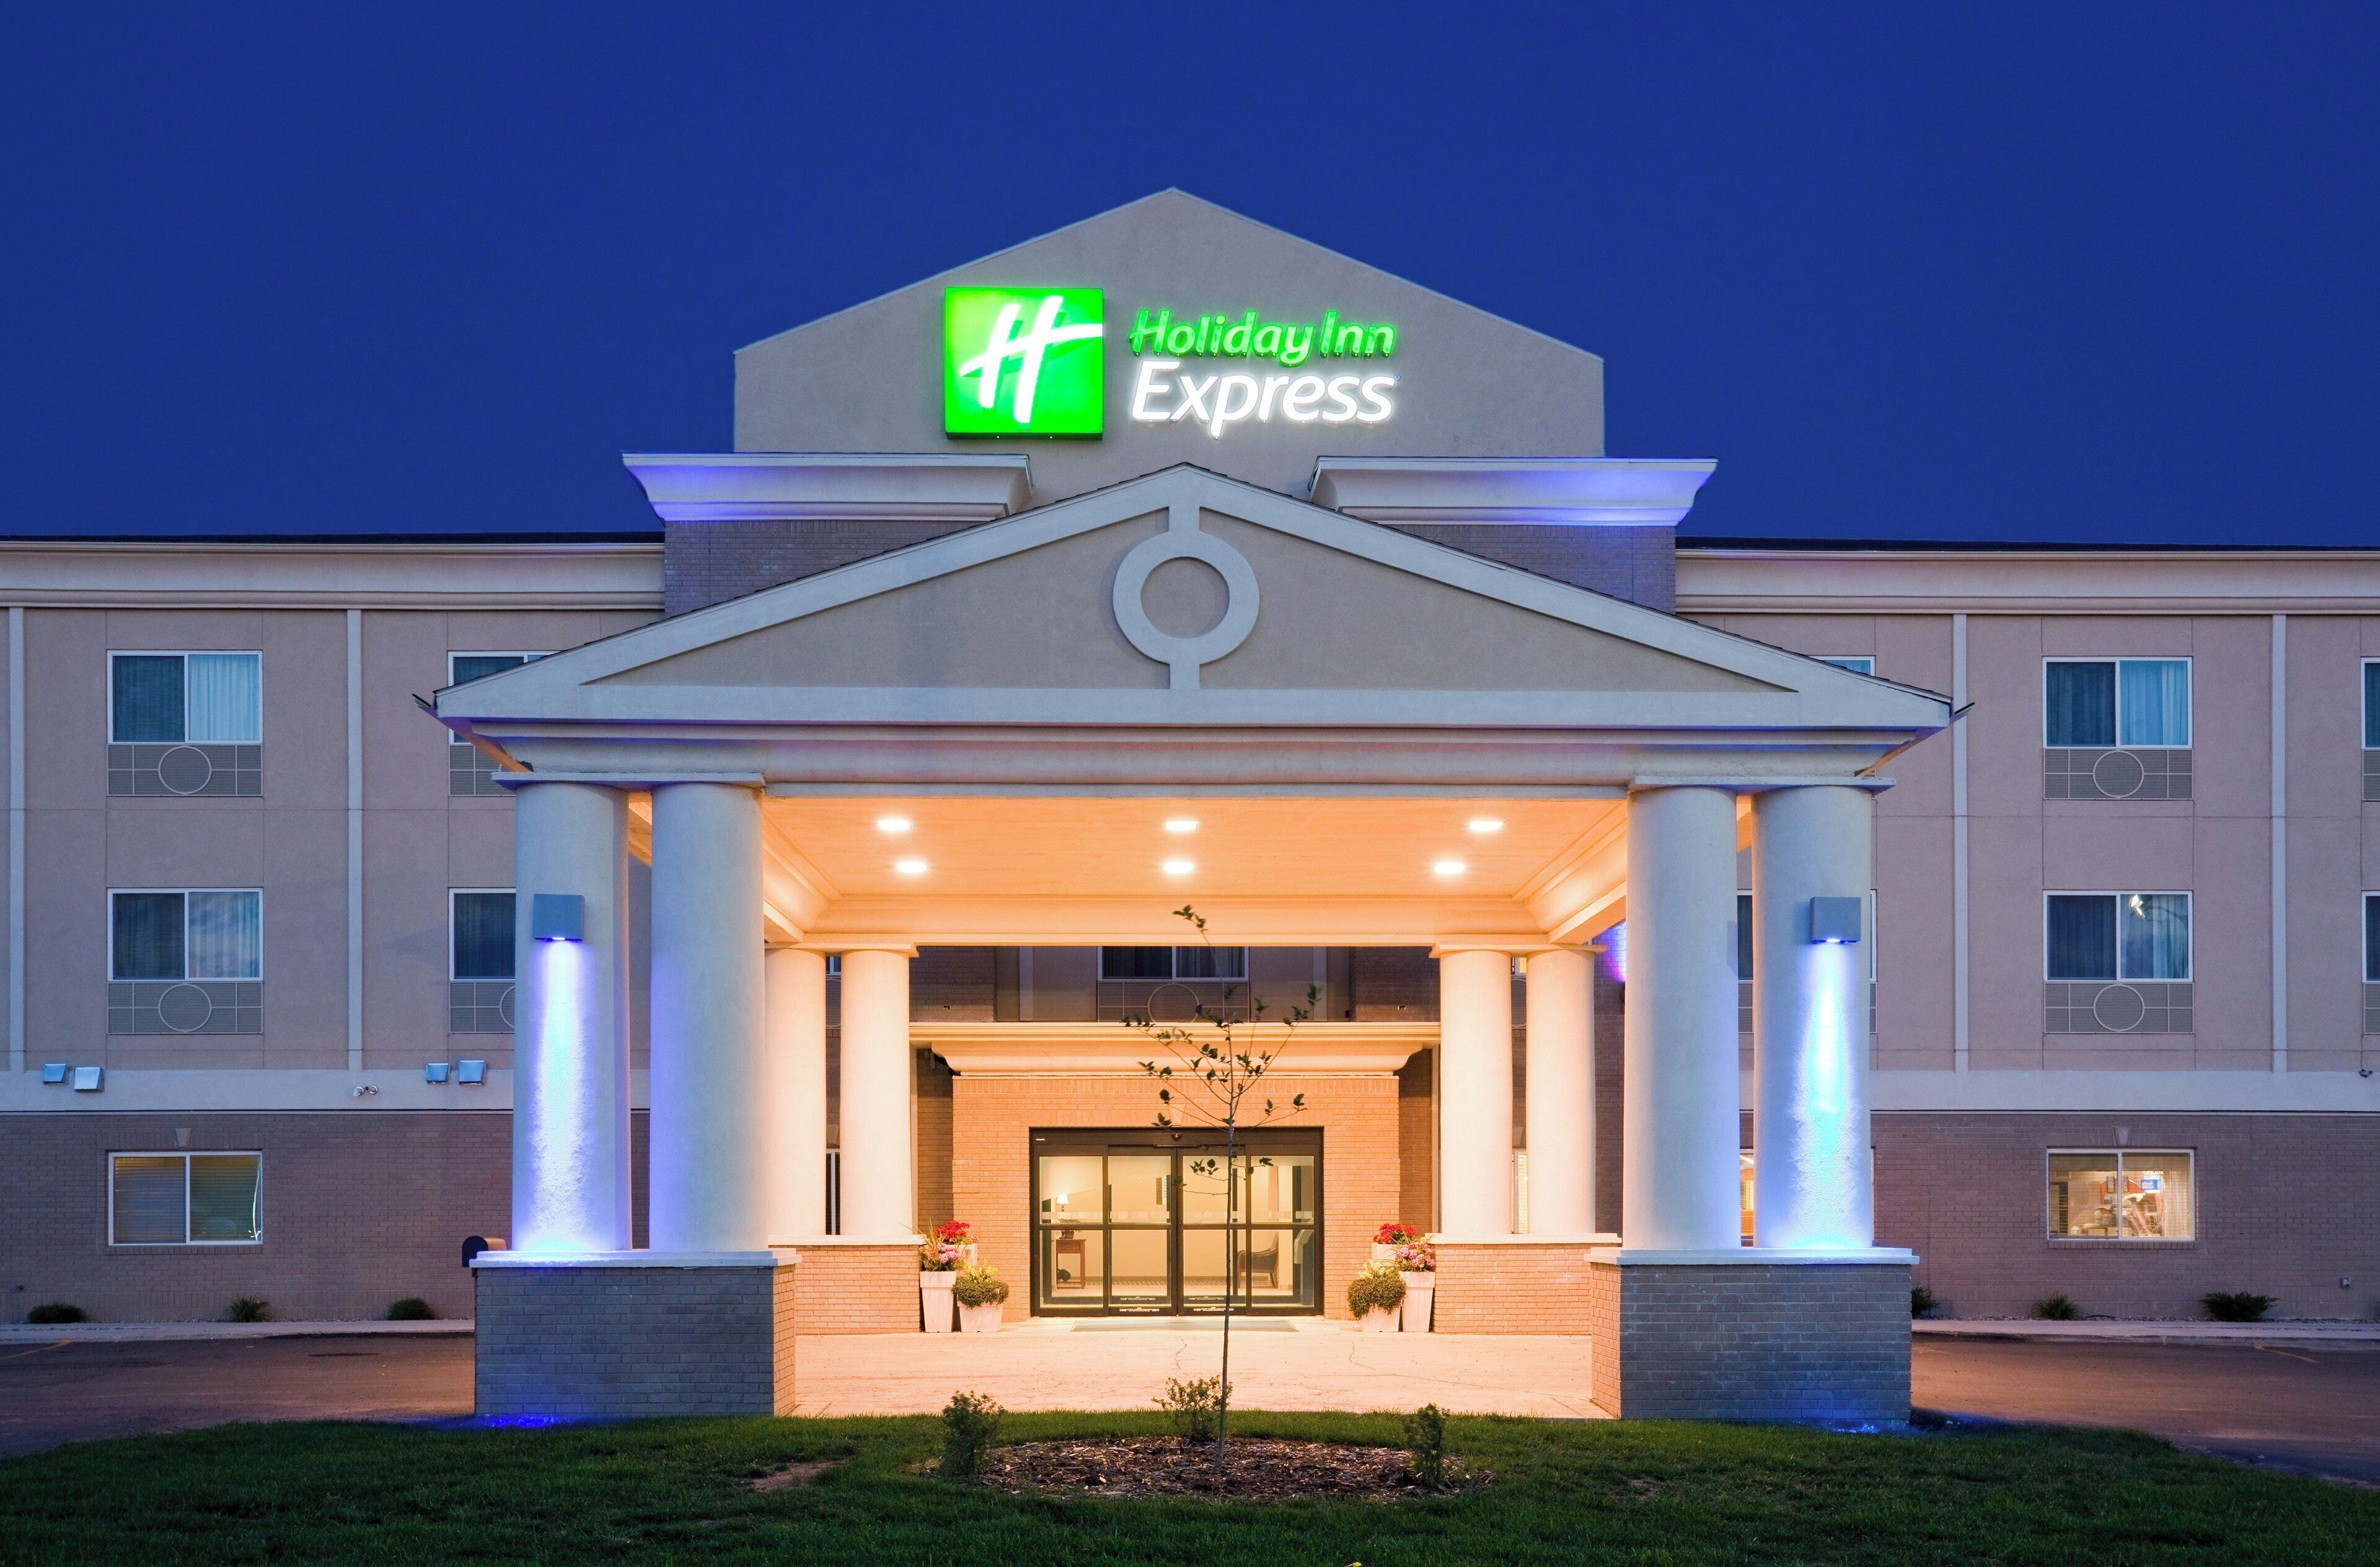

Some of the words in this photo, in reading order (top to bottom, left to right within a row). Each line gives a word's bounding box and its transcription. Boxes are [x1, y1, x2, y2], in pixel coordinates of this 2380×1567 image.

[1129, 309, 1315, 366] Holiday
[1320, 310, 1396, 356] Inn
[1131, 361, 1395, 440] Express
